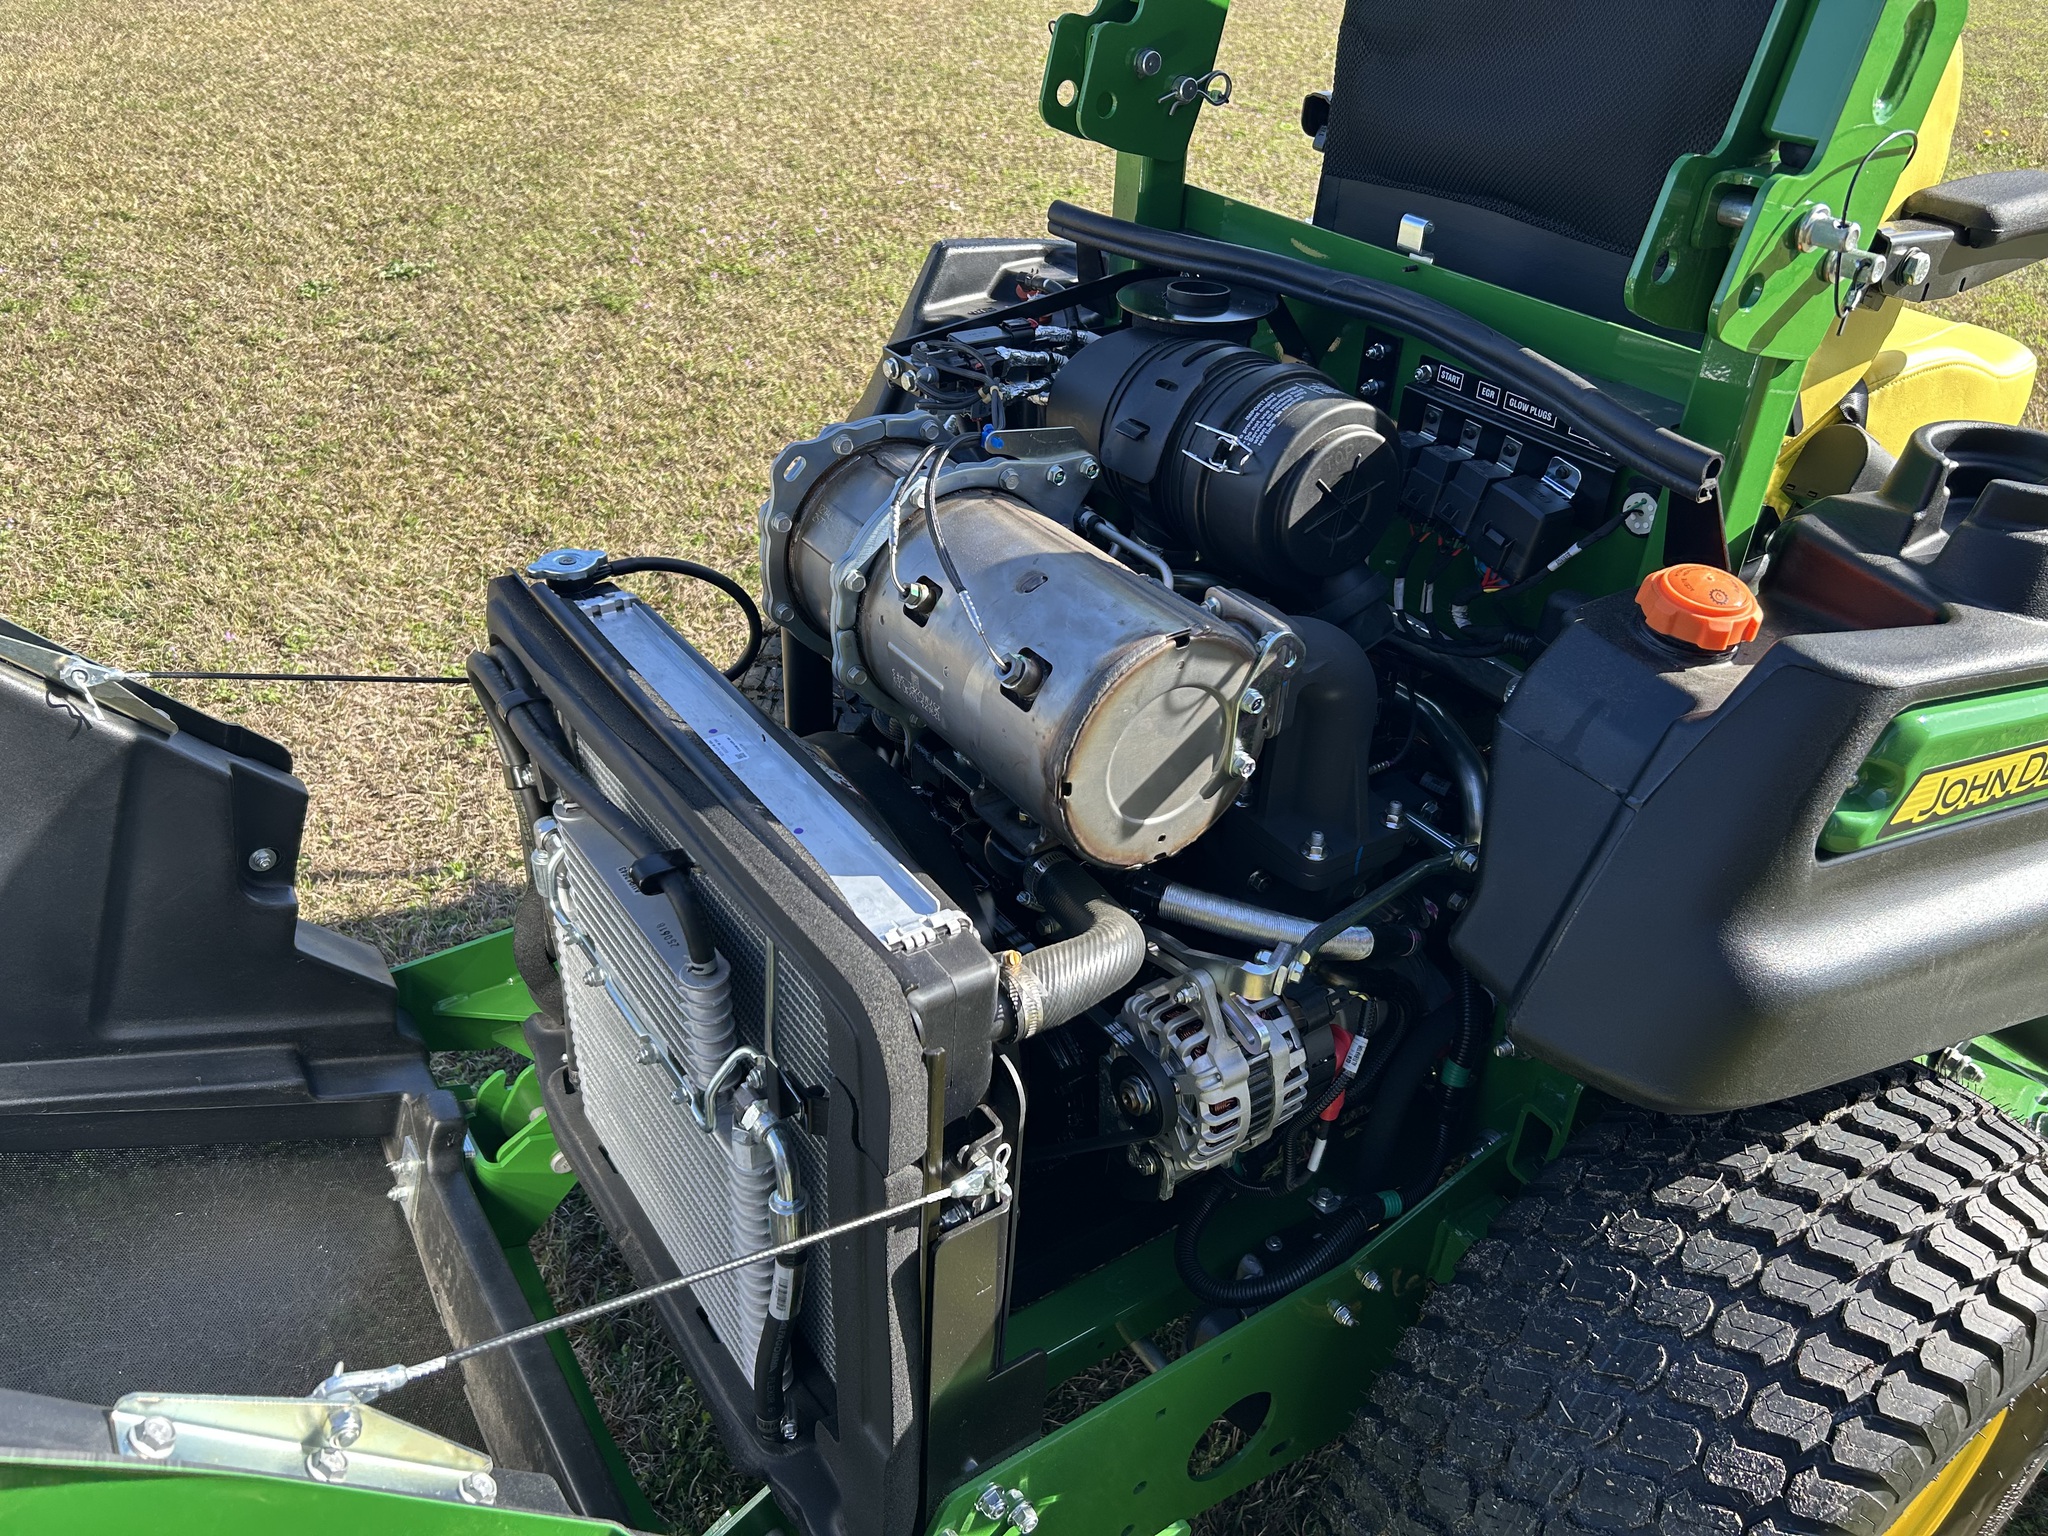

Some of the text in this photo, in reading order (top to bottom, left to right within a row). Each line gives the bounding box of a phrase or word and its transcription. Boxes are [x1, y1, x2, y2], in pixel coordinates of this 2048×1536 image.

[1440, 370, 1461, 385] START
[1481, 386, 1496, 399] EGR
[1245, 392, 1276, 420] IMPORTANT
[1508, 398, 1553, 422] GLOW PLUGS
[1251, 420, 1261, 431] not
[1260, 410, 1270, 420] use
[1257, 423, 1276, 446] red line
[1324, 443, 1355, 472] TOP
[1917, 764, 2017, 817] JOHN
